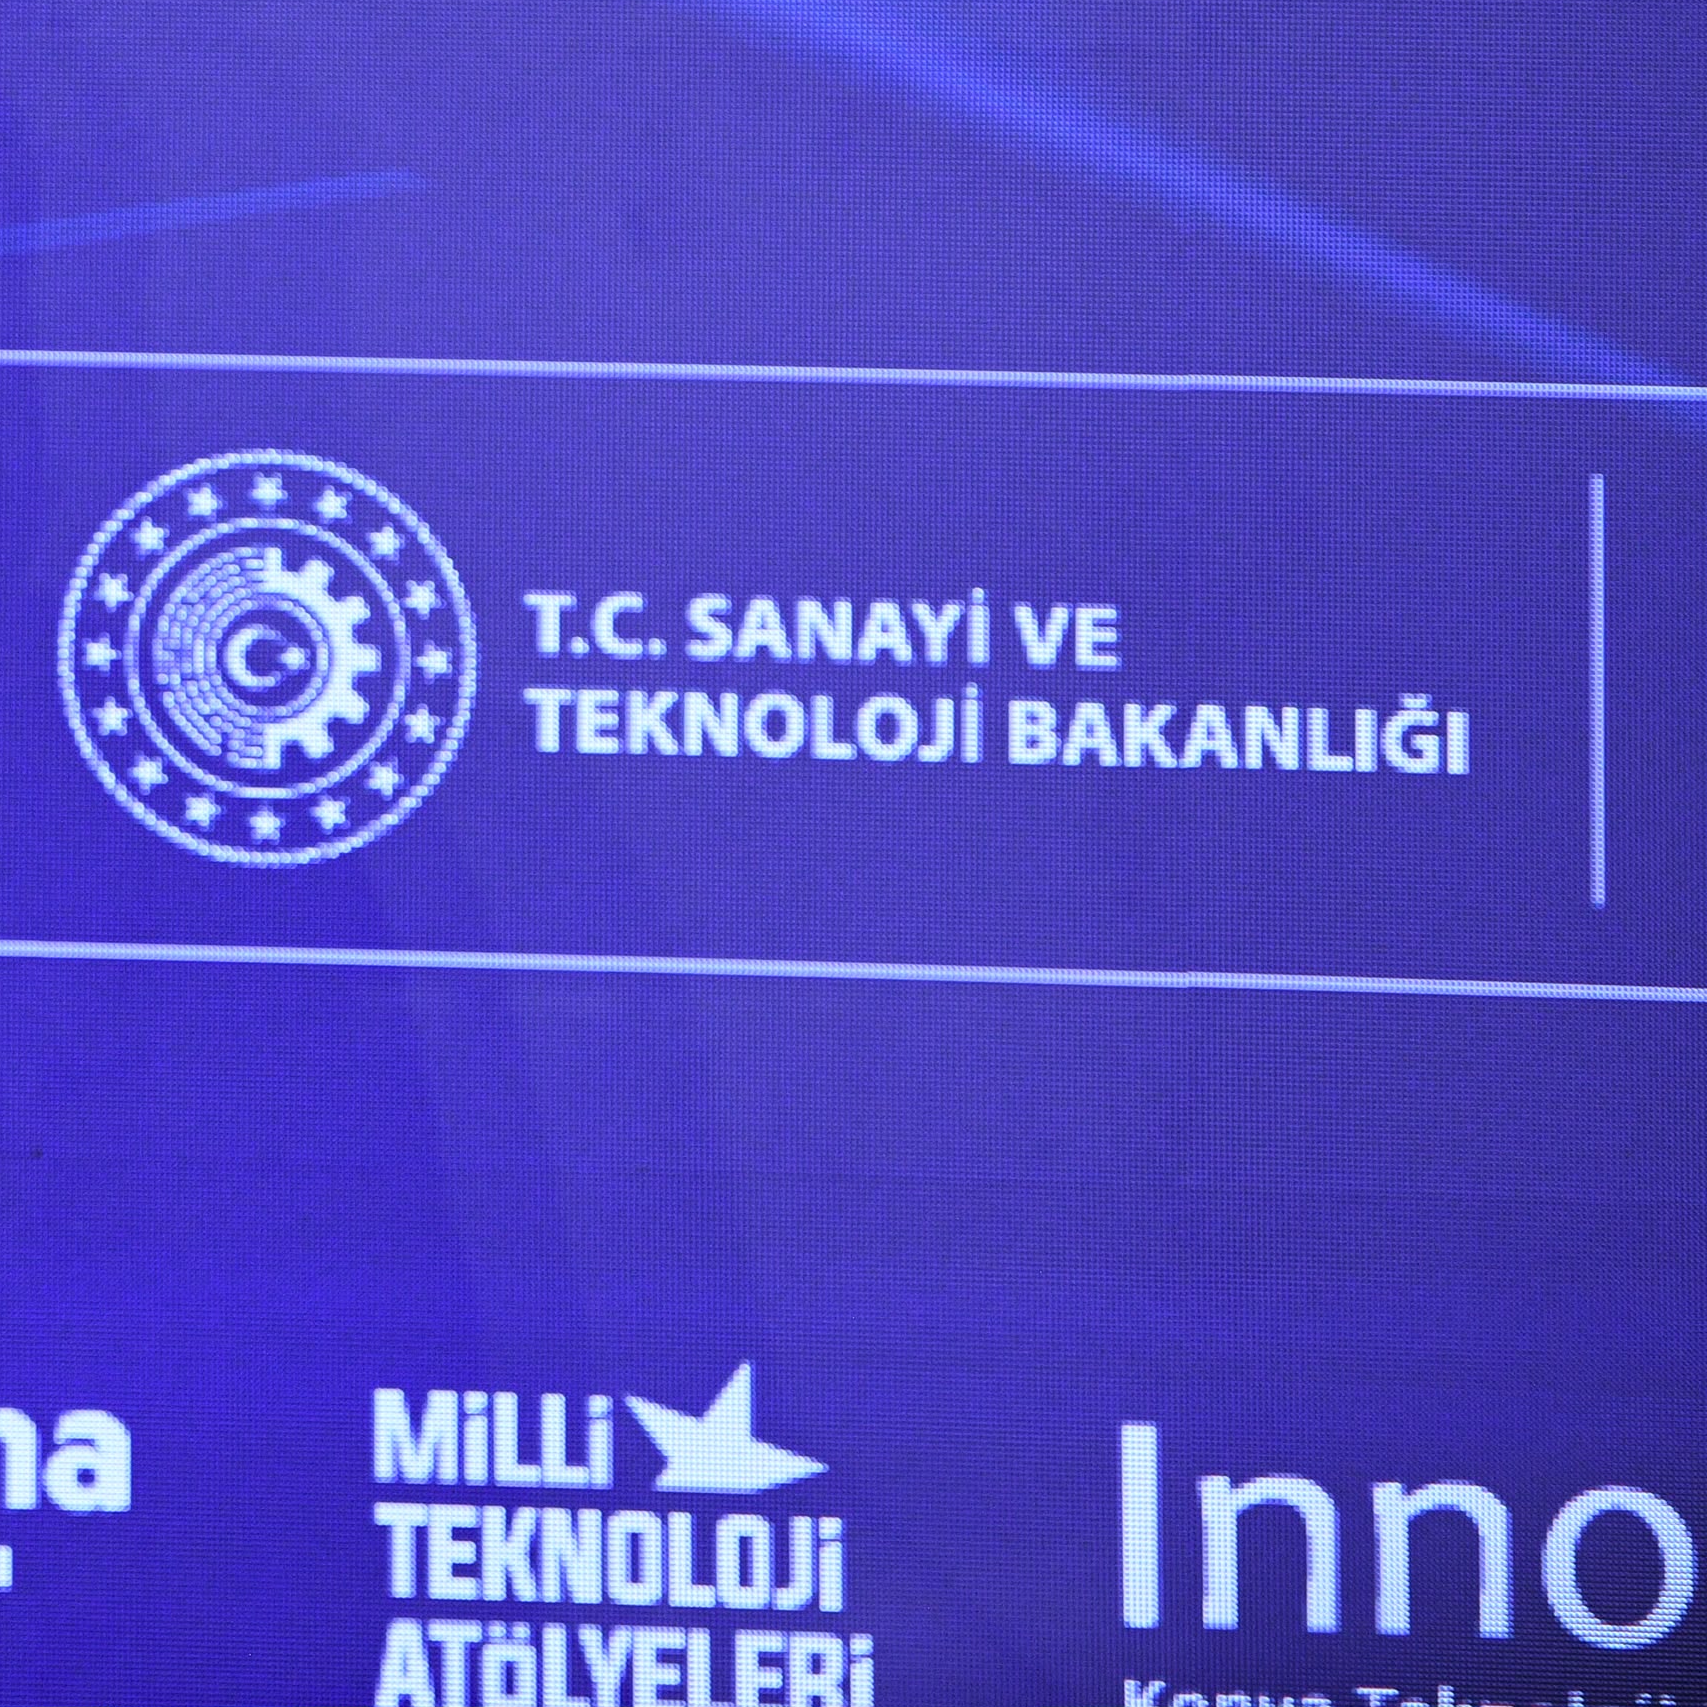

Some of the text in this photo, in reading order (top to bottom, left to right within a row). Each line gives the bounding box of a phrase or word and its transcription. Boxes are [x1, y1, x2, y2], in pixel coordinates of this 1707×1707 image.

[524, 588, 1118, 667] T.C. SANAYİ VE
[524, 685, 1468, 774] TEKNOLOJİ BAKANLIĞI
[1121, 1423, 1693, 1648] Inno
